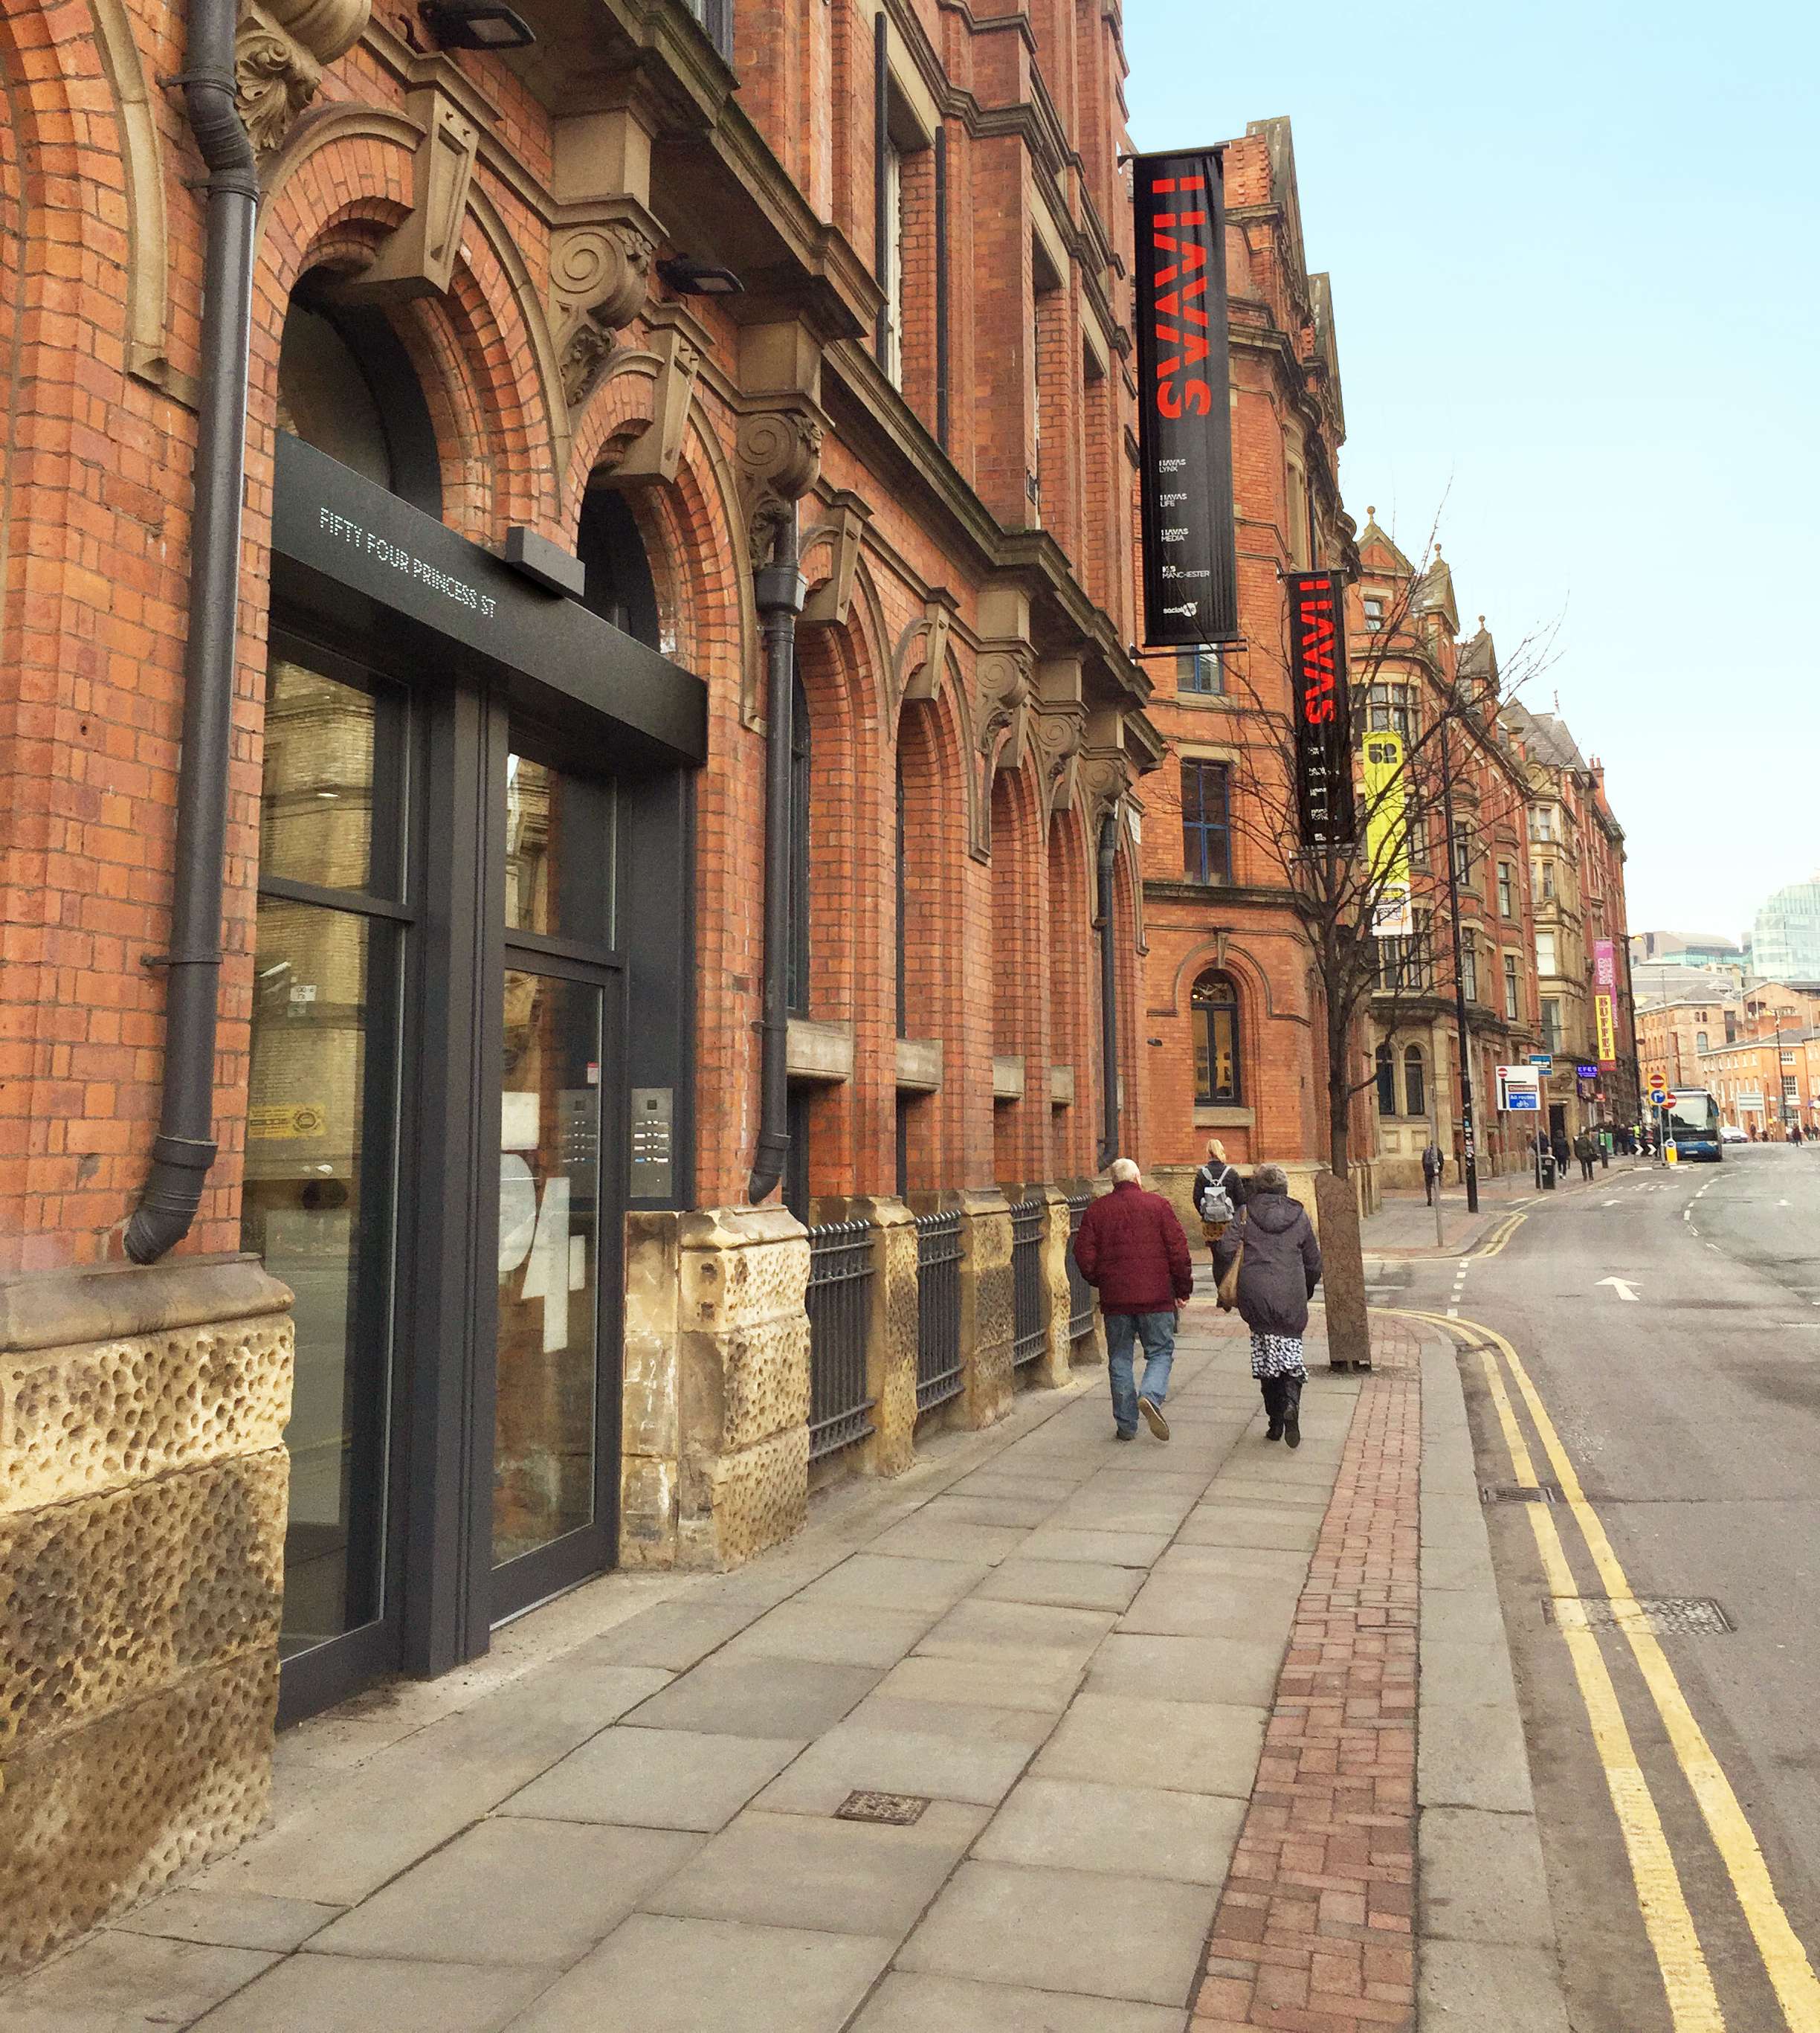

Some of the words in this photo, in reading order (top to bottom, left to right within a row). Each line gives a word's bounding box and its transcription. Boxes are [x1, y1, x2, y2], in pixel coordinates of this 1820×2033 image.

[1152, 176, 1211, 419] HAVAS
[320, 507, 363, 547] FIFTY
[367, 532, 410, 573] FOUR
[413, 558, 477, 609] PRINCESS
[480, 595, 497, 618] ST
[1162, 570, 1210, 579] MANCHESTER
[1300, 580, 1335, 724] HAVAS
[1368, 743, 1398, 764] 52
[1598, 997, 1611, 1059] BUFFET
